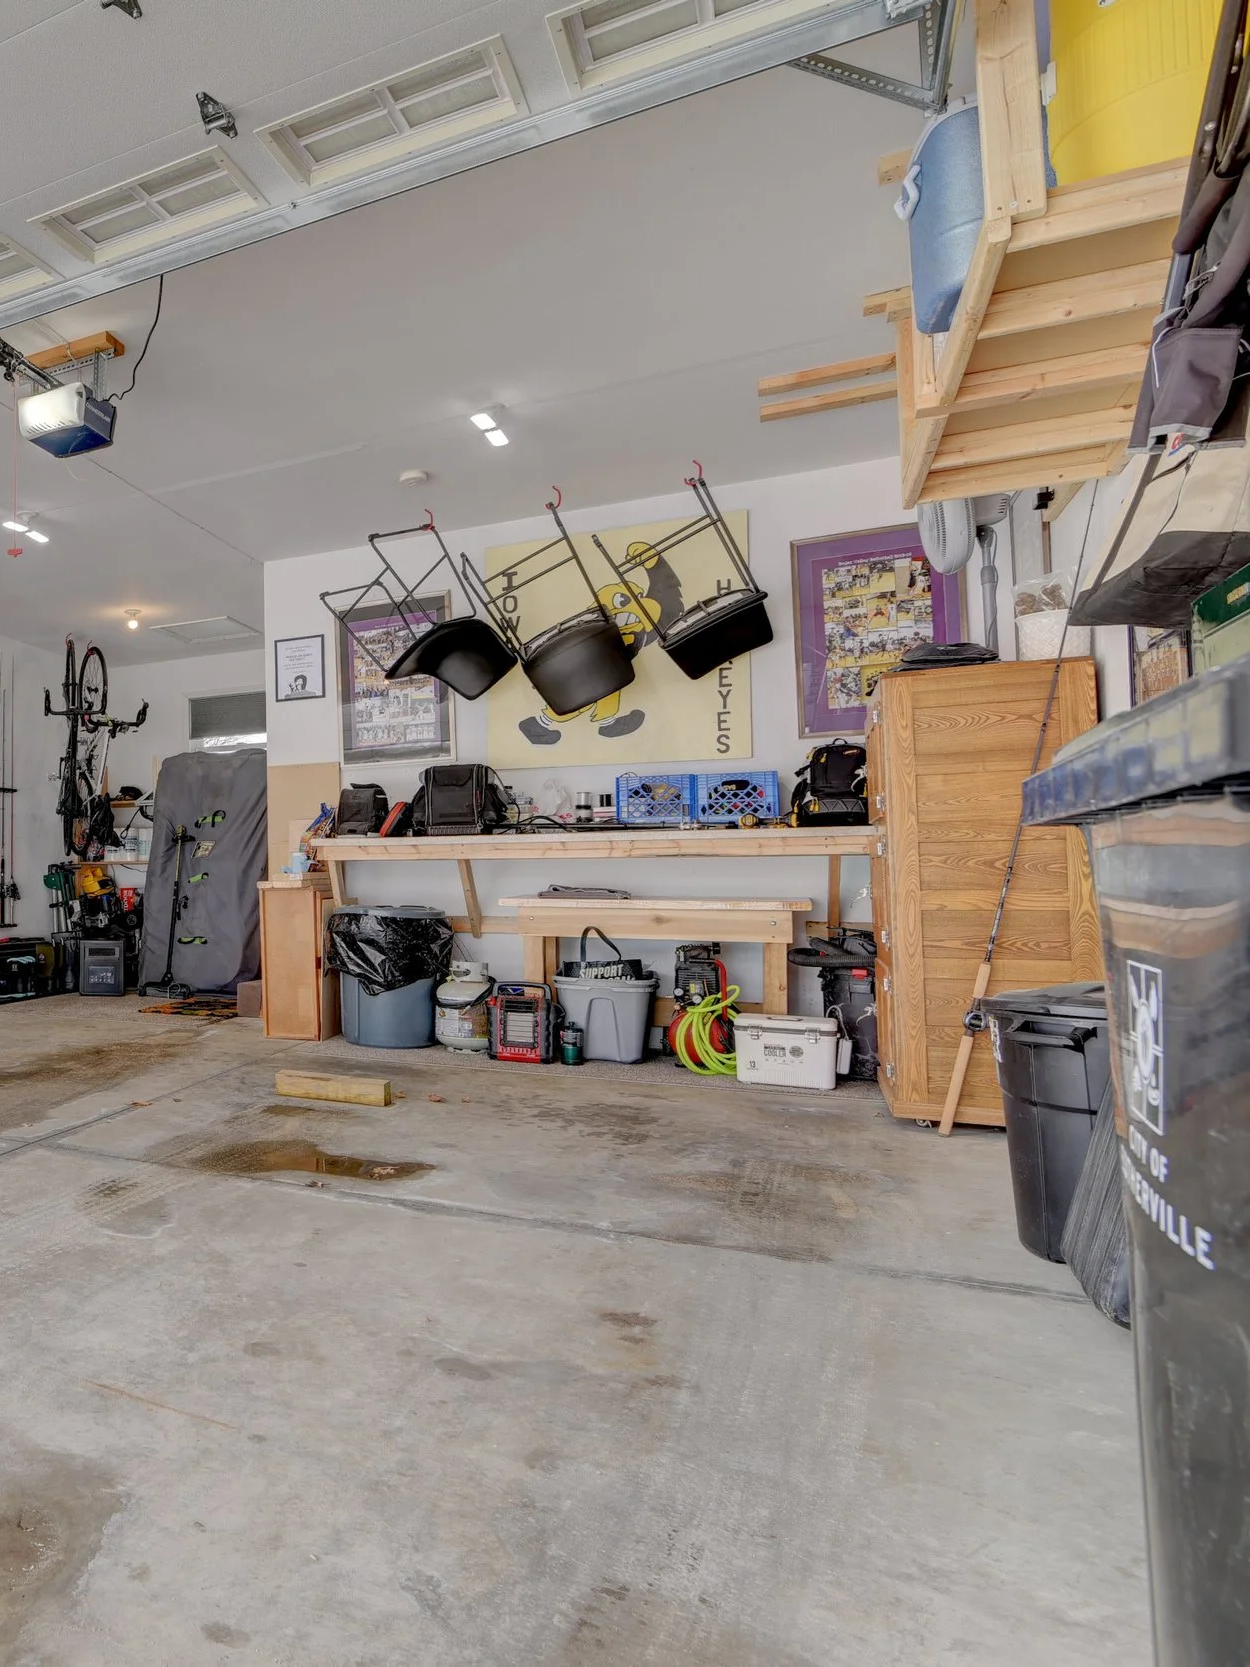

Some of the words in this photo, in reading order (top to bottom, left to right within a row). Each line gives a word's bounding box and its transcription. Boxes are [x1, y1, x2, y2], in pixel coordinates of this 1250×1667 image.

[499, 571, 521, 643] IOW
[716, 578, 732, 754] HEYES
[580, 963, 624, 979] SUPPORT
[749, 1060, 756, 1068] 13
[763, 1048, 787, 1058] COOLER
[1129, 1124, 1148, 1165] CITY
[1150, 1147, 1169, 1183] OF
